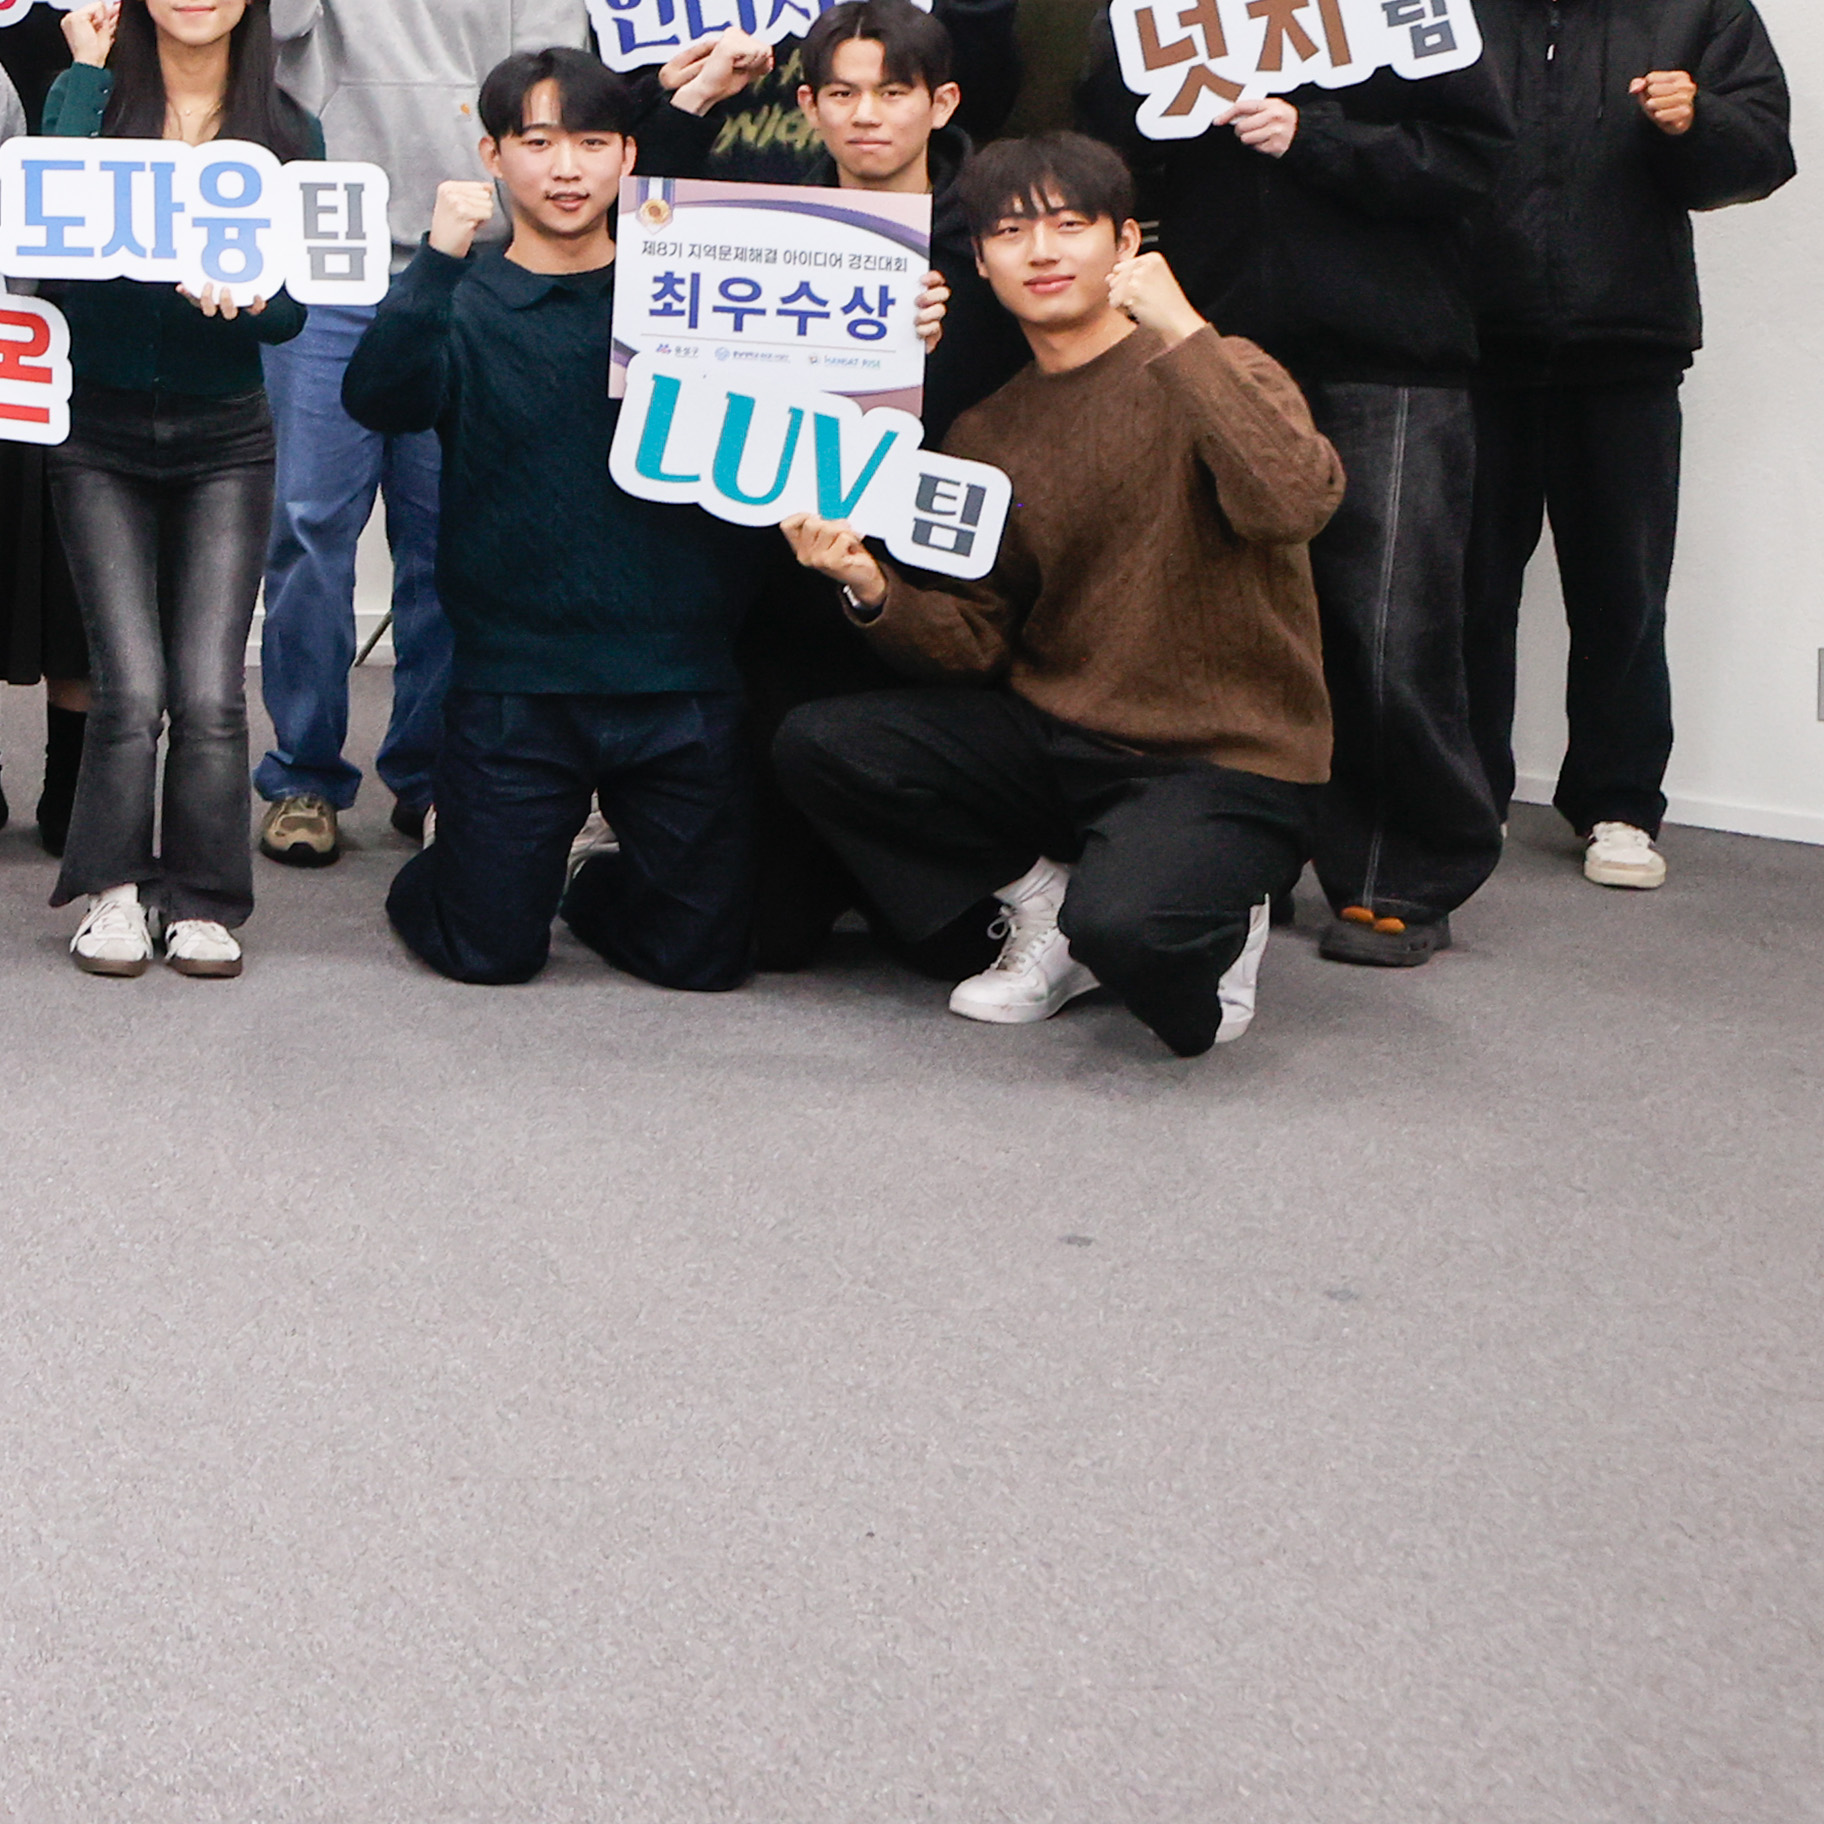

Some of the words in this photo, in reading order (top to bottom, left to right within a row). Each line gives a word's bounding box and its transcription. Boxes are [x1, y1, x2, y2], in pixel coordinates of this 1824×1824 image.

[16, 156, 272, 284] 도자융
[297, 179, 368, 283] 팀
[642, 240, 683, 259] 제8기
[687, 243, 778, 265] 지역문제해결
[782, 249, 844, 269] 아이디어
[848, 253, 908, 273] 경진대회
[648, 270, 897, 342] 최우수상
[635, 373, 899, 522] LUV
[911, 471, 986, 558] 팀
